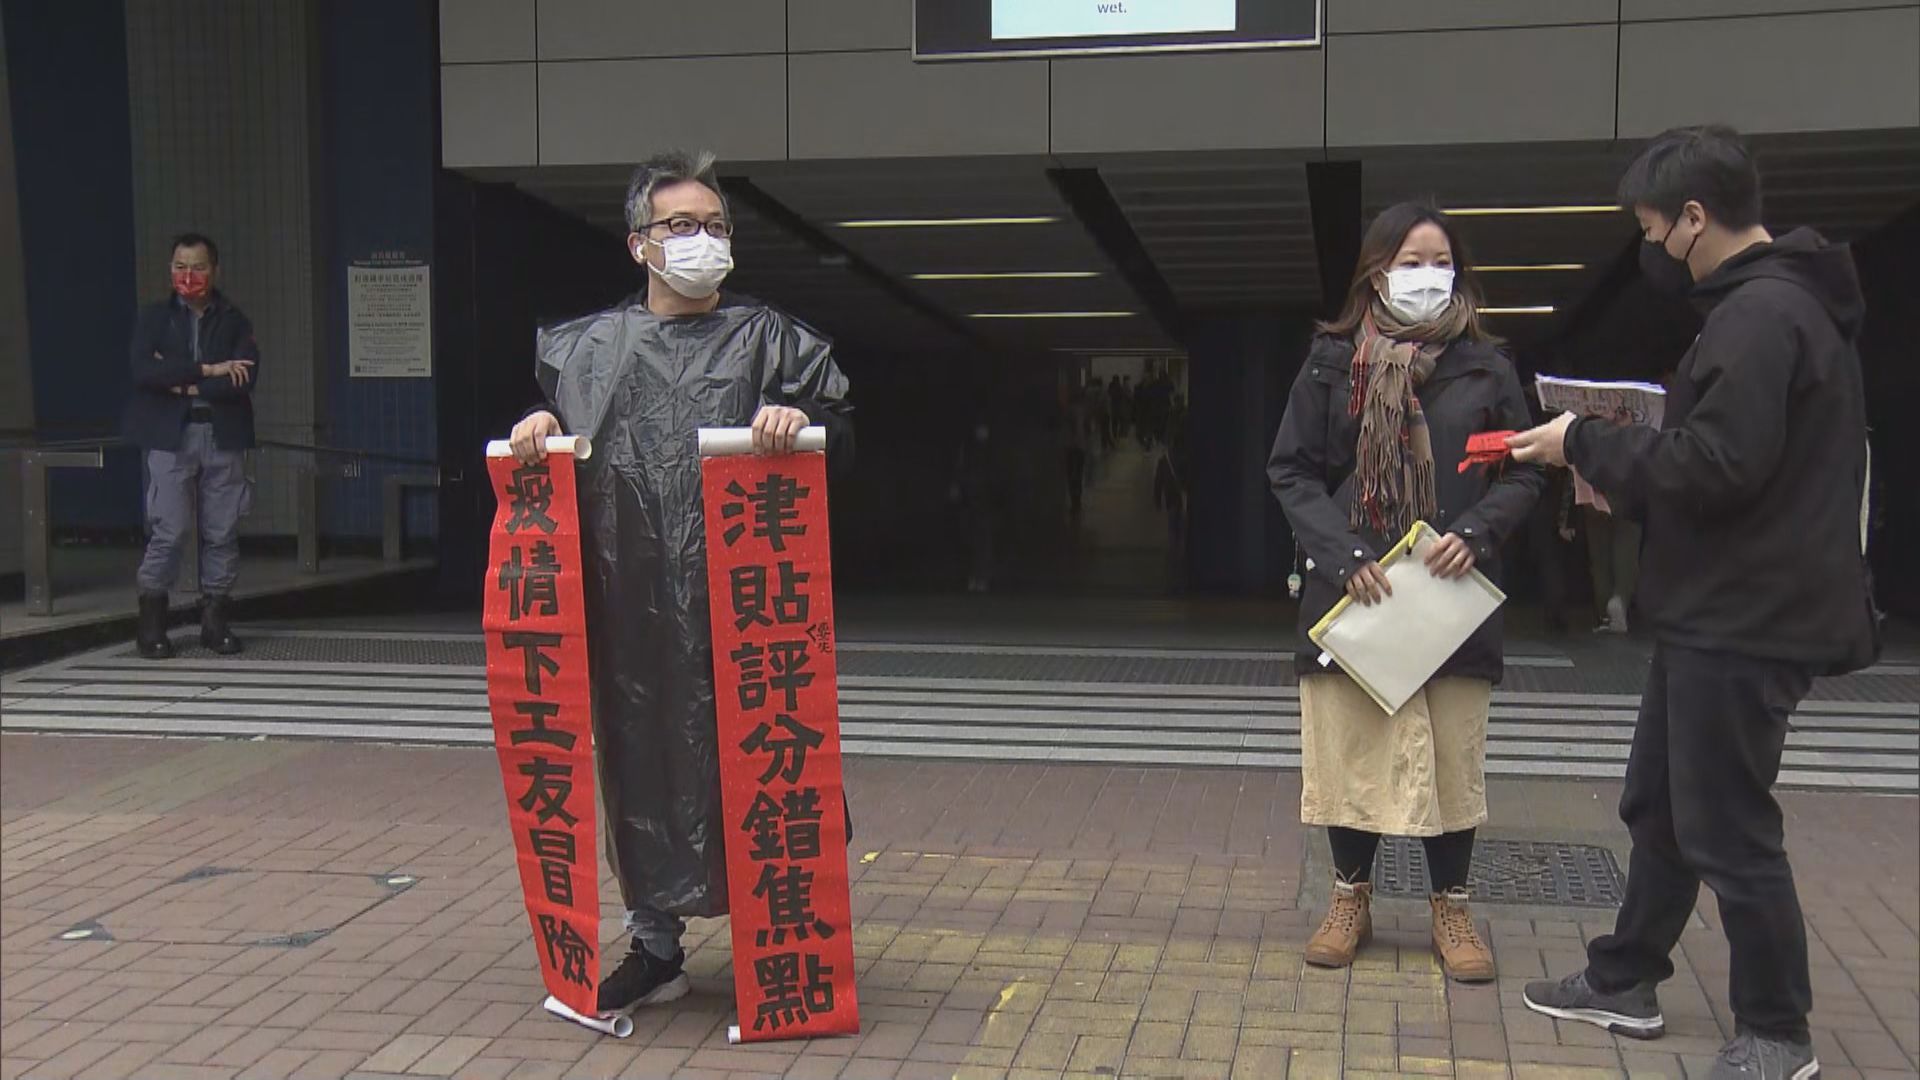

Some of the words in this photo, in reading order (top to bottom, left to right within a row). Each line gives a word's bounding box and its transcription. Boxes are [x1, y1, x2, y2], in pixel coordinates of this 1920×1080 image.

[1097, 2, 1127, 13] wet.
[499, 465, 594, 991] 疫情下工友冒險
[721, 474, 835, 1031] 津貼評分錯焦點
